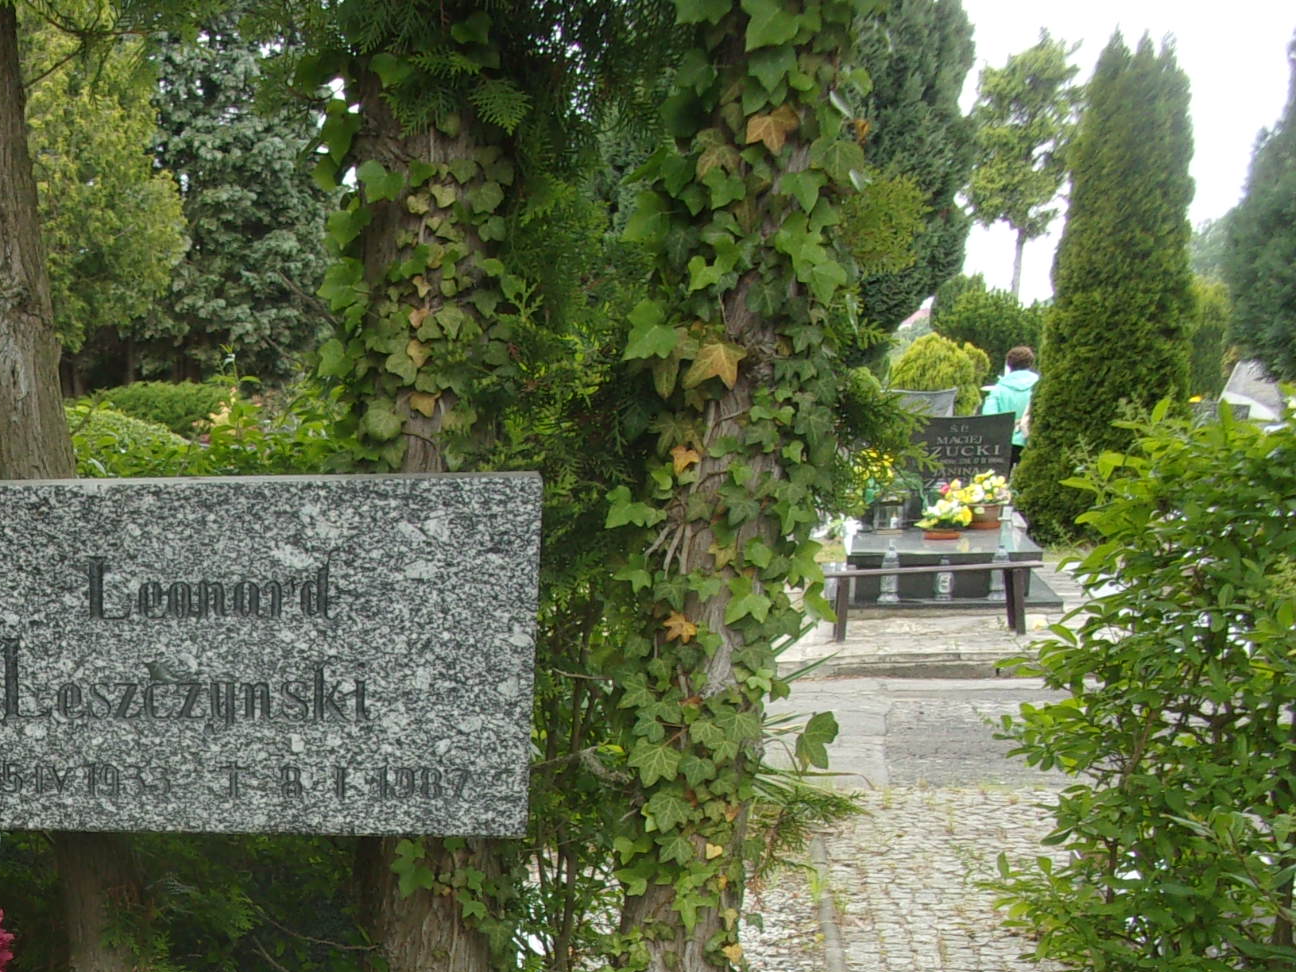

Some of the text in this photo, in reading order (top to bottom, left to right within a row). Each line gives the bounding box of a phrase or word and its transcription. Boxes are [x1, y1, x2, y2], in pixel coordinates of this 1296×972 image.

[936, 435, 983, 445] MACIEJ
[918, 444, 1001, 457] ZUCKI
[88, 552, 341, 622] Leonard
